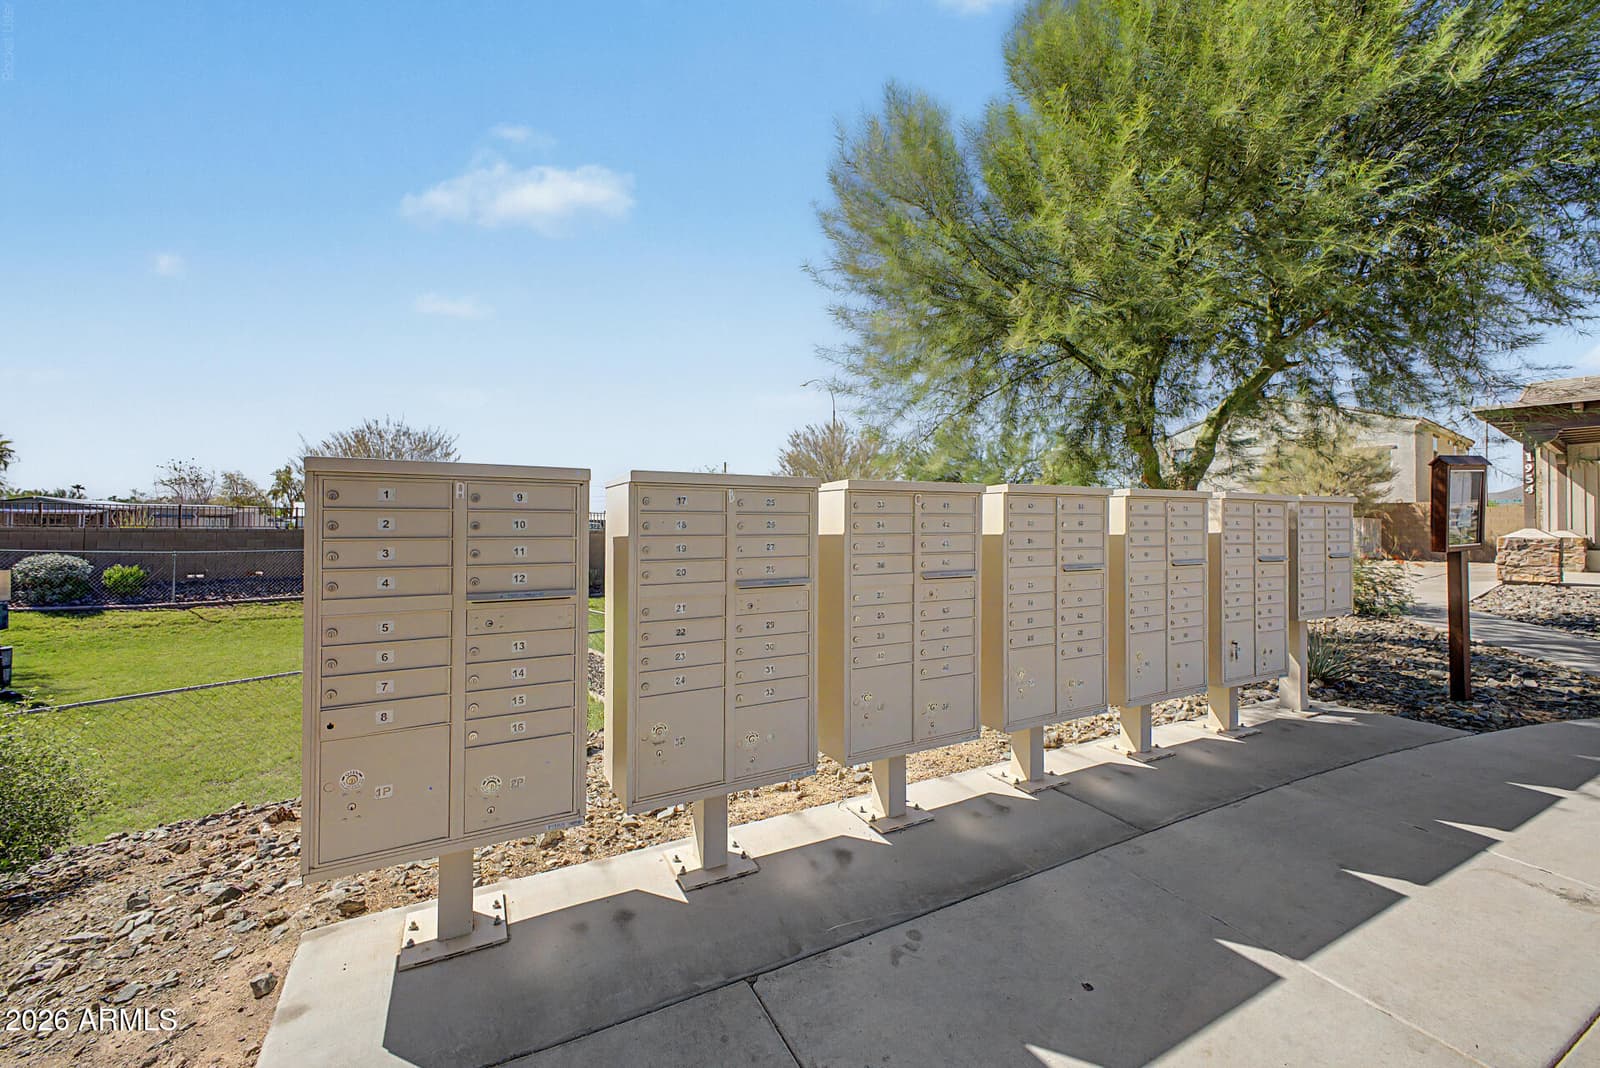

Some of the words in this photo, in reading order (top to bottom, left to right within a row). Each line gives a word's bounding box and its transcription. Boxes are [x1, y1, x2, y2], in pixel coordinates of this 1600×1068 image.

[1525, 452, 1535, 495] 1954
[384, 490, 389, 499] 1
[517, 493, 523, 502] 9
[383, 520, 390, 529] 2
[515, 521, 526, 529] 10
[382, 549, 389, 558] 3
[676, 568, 687, 577] 20
[382, 579, 389, 587] 4
[514, 574, 526, 583] 12
[676, 604, 686, 612] 21
[382, 623, 389, 632] 5
[514, 642, 525, 650] 13
[381, 653, 388, 662] 6
[512, 669, 524, 677] 14
[381, 682, 388, 692] 7
[512, 696, 524, 705] 15
[380, 712, 388, 722] 8
[512, 723, 524, 732] 16
[376, 787, 391, 797] 1P
